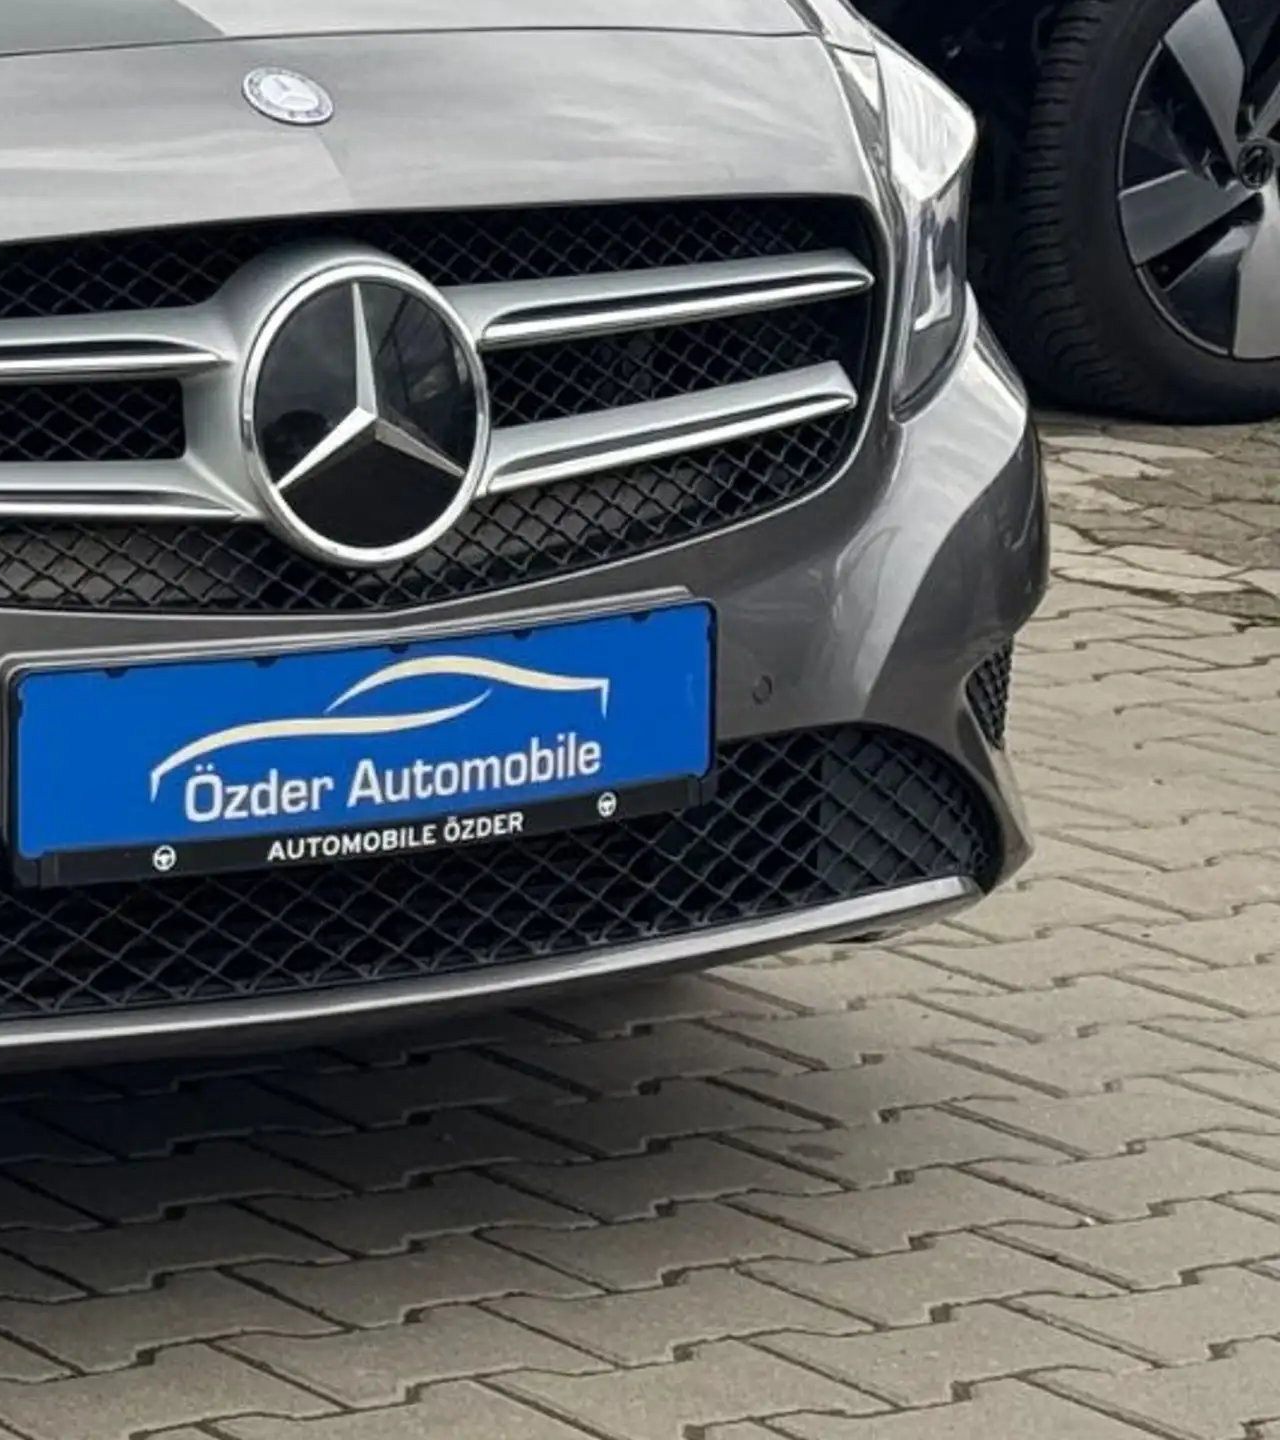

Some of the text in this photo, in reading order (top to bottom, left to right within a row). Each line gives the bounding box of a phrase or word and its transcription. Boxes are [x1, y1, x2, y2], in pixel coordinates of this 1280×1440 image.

[184, 731, 603, 824] Özder Automobile
[267, 811, 525, 863] AUTOMOBILE ÖZDER
